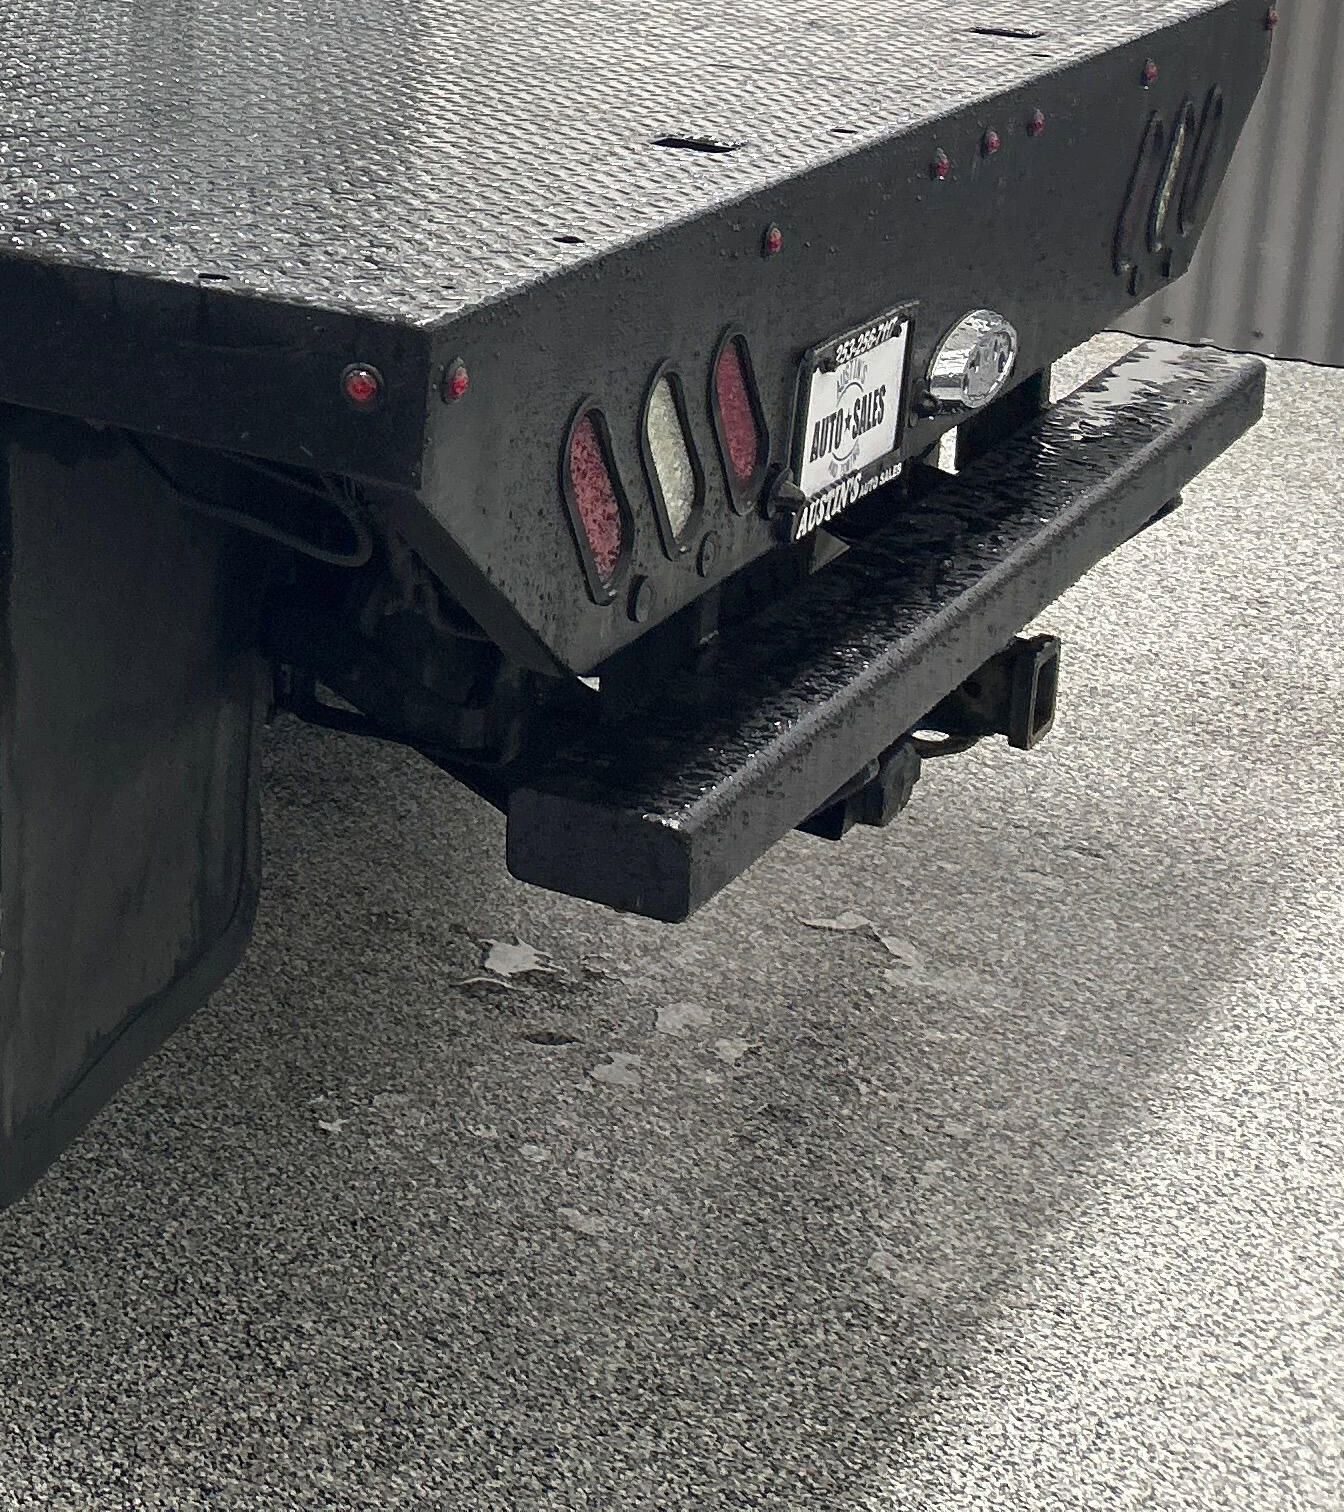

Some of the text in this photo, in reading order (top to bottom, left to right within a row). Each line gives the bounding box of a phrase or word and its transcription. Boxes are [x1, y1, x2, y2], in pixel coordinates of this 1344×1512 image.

[809, 407, 844, 463] AUTO
[852, 384, 886, 439] SALES
[795, 473, 862, 540] AUSTIN'S
[879, 462, 903, 486] SALES
